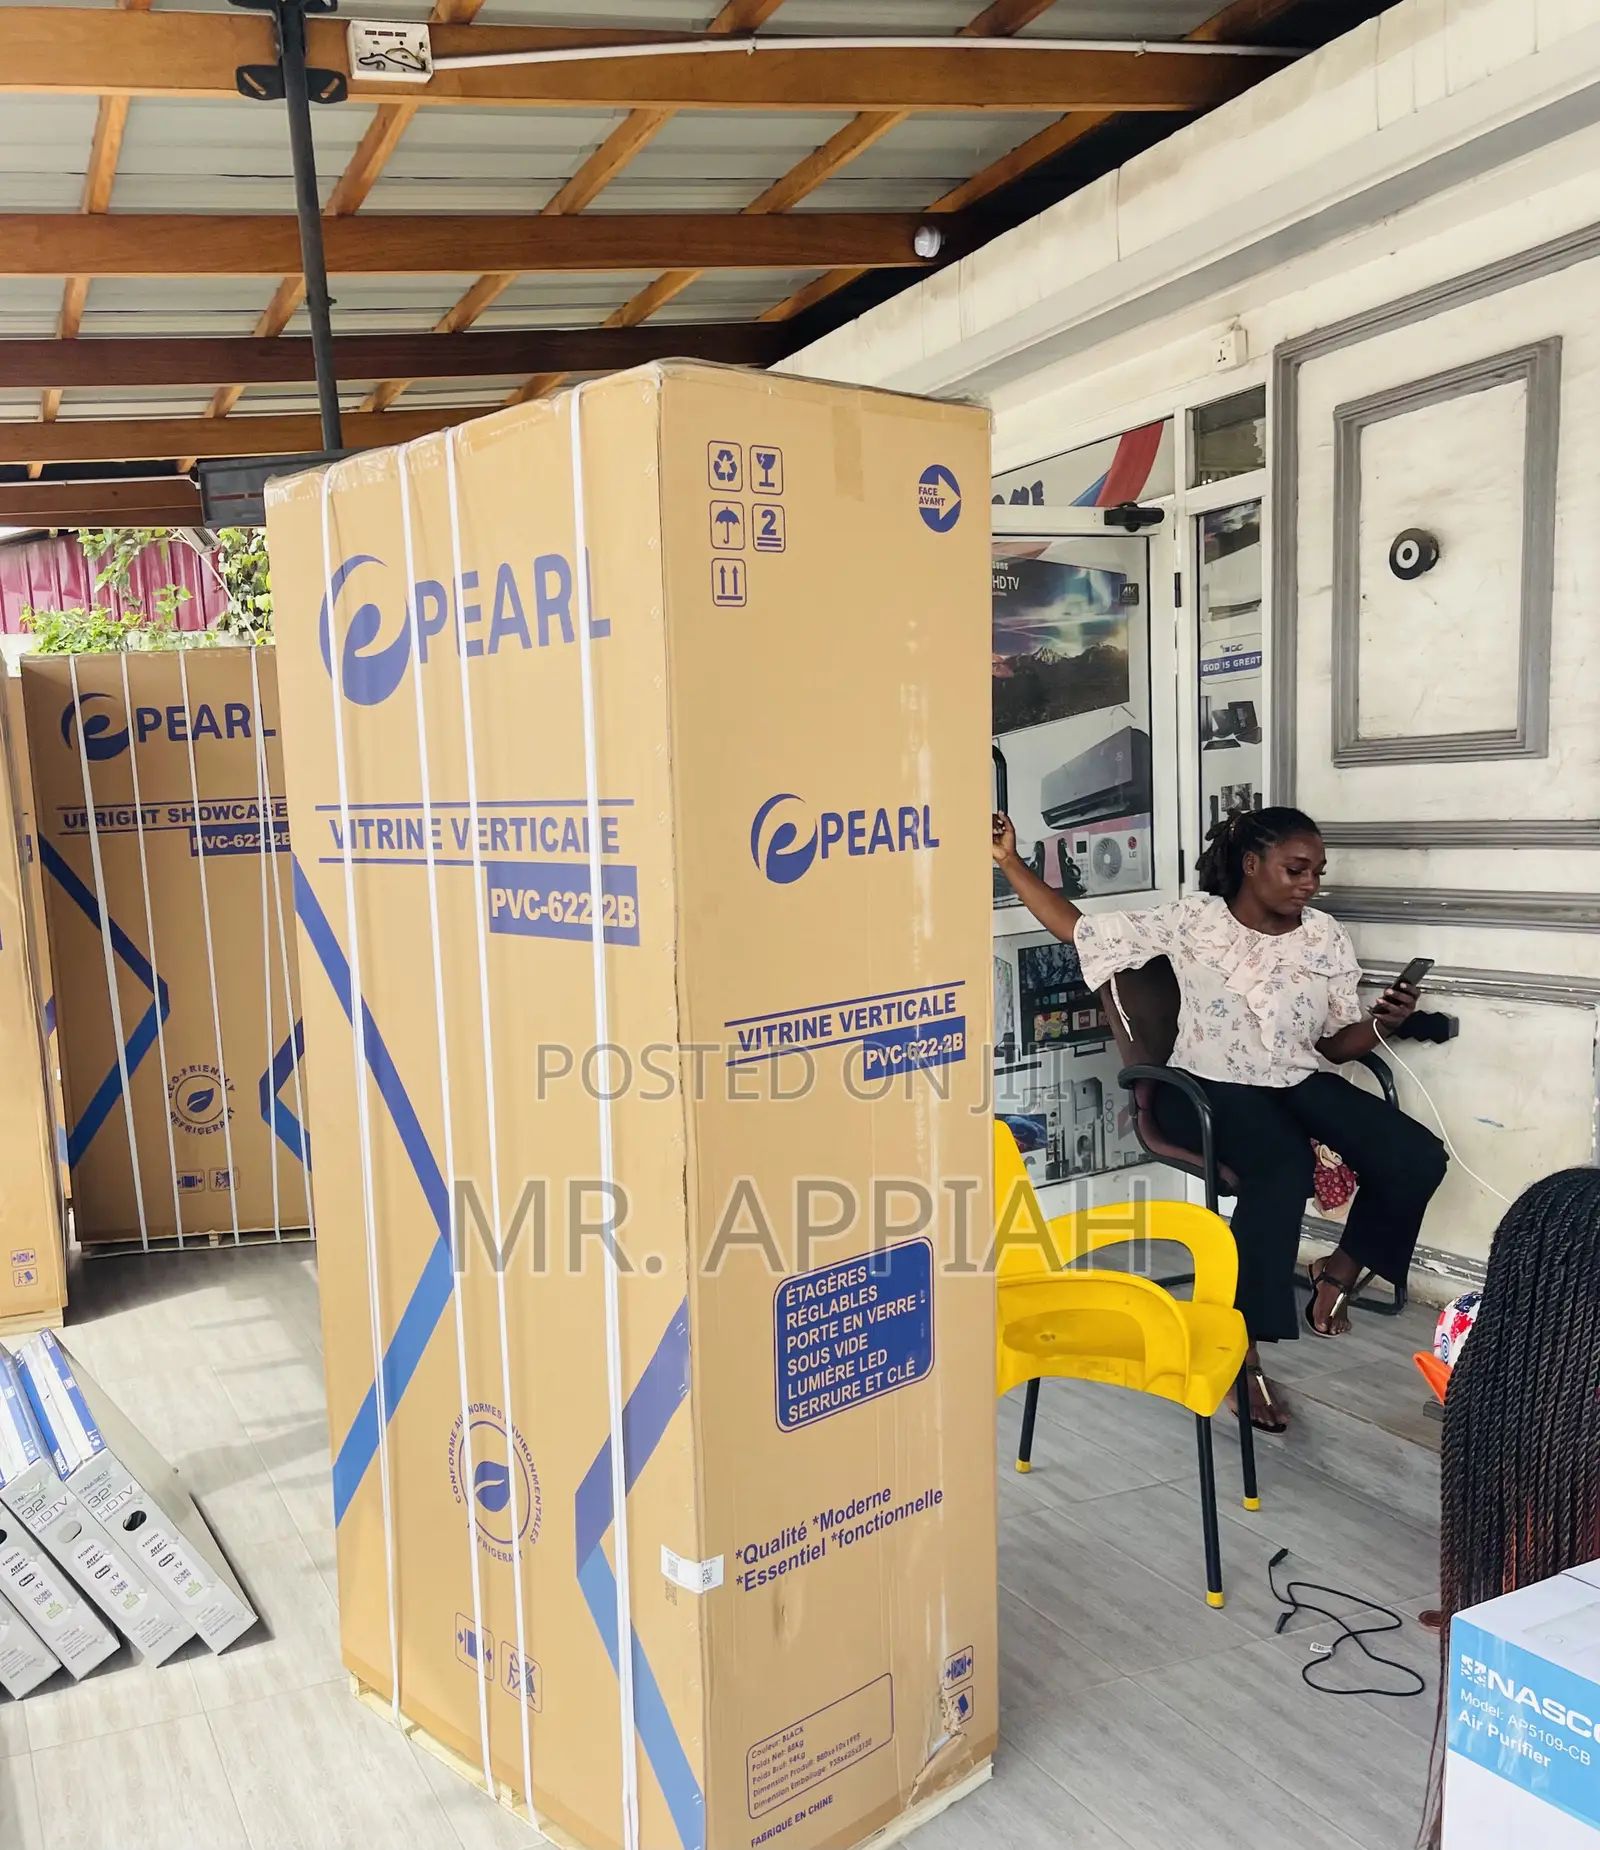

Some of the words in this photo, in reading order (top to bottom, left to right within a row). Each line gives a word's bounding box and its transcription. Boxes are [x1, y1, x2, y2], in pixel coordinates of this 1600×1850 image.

[919, 486, 938, 496] FACE
[919, 496, 945, 506] AVANT
[761, 509, 777, 535] 2
[414, 547, 611, 664] PEARL
[1203, 662, 1220, 672] GOD
[1222, 660, 1230, 669] IS
[1233, 655, 1261, 667] GREAT
[136, 702, 277, 743] PEARL
[167, 802, 287, 823] SHOWCASE
[821, 804, 940, 860] PEARL
[329, 818, 443, 850] VITRINE
[450, 816, 620, 854] VERTICALE
[1128, 851, 1137, 859] LG
[490, 887, 637, 928] PVC-6222B
[738, 1014, 832, 1052] VITRINE
[839, 992, 956, 1033] VERTICALE
[866, 1032, 964, 1070] PVC-622-2B
[786, 1266, 867, 1307] ÉTAGÈRES
[786, 1285, 878, 1331] RÉGLABLES
[787, 1321, 839, 1353] PORTE
[843, 1312, 863, 1333] EN
[867, 1294, 916, 1324] VERRE
[787, 1347, 830, 1376] SOUS
[834, 1333, 868, 1358] VIDE
[788, 1360, 855, 1400] LUMIÈRE
[860, 1349, 888, 1373] LED
[788, 1381, 861, 1423] SERRURE
[865, 1372, 883, 1393] ET
[887, 1358, 916, 1384] CLÉ
[468, 1402, 502, 1420] NORMES
[504, 1416, 542, 1545] NVIRONMENTALES
[31, 1496, 68, 1529] HDTV
[97, 1485, 133, 1518] HDTV
[1461, 1688, 1503, 1721] Model:
[1508, 1714, 1591, 1766] AP5109-CB
[1488, 1670, 1600, 1745] NASC
[1458, 1710, 1482, 1731] Air
[1488, 1725, 1551, 1768] Purifier
[751, 1817, 793, 1848] FABRIQUÉ
[795, 1811, 806, 1824] EN
[808, 1794, 834, 1815] CHINE
